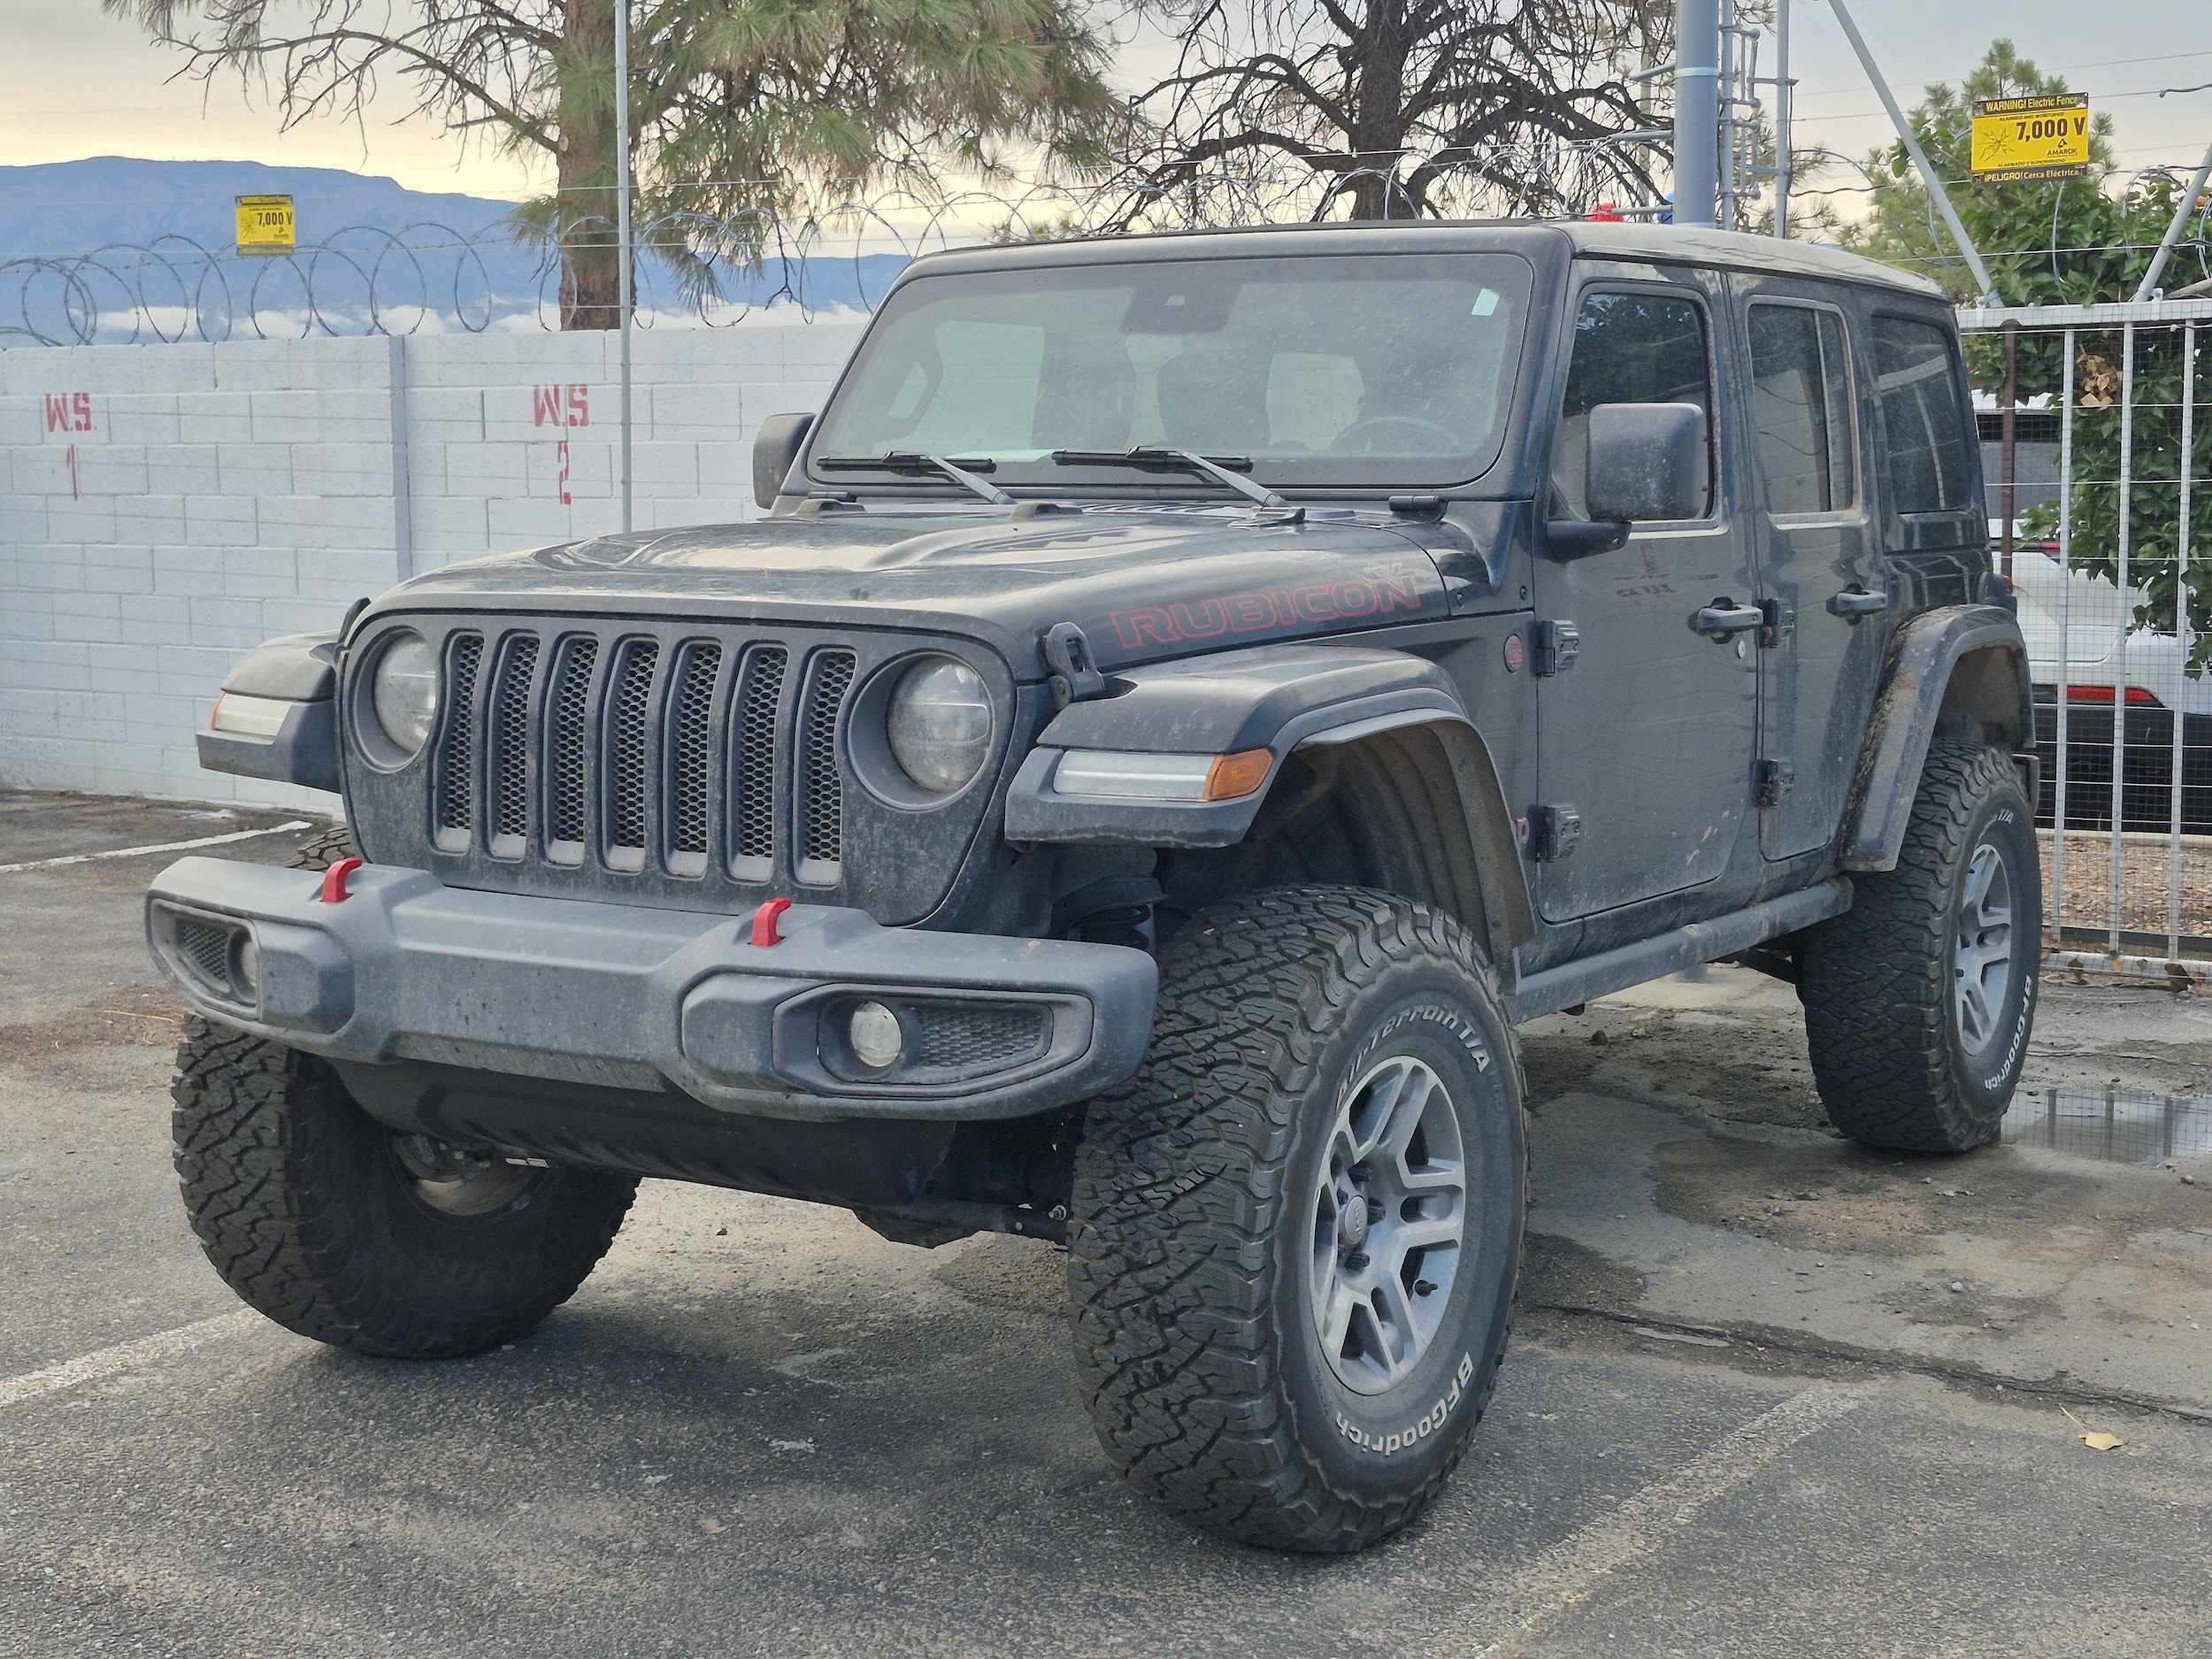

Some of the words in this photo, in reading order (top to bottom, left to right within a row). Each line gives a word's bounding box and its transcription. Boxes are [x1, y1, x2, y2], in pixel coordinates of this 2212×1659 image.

[1985, 100, 2027, 112] WARNING!
[2028, 97, 2055, 109] Electric
[2056, 96, 2079, 105] Fence
[2016, 119, 2068, 142] 7,000
[2073, 117, 2086, 135] V
[2047, 148, 2078, 157] AMAROK
[2024, 171, 2045, 180] Cerca
[257, 211, 284, 228] 7,000
[286, 211, 293, 226] V
[66, 443, 79, 502] 1
[557, 441, 572, 505] 2
[1110, 575, 1422, 650] RUBICON
[1997, 808, 2015, 825] T/A
[1984, 974, 2032, 1091] BFGoodrich
[1335, 1350, 1475, 1457] BFGoodrich
